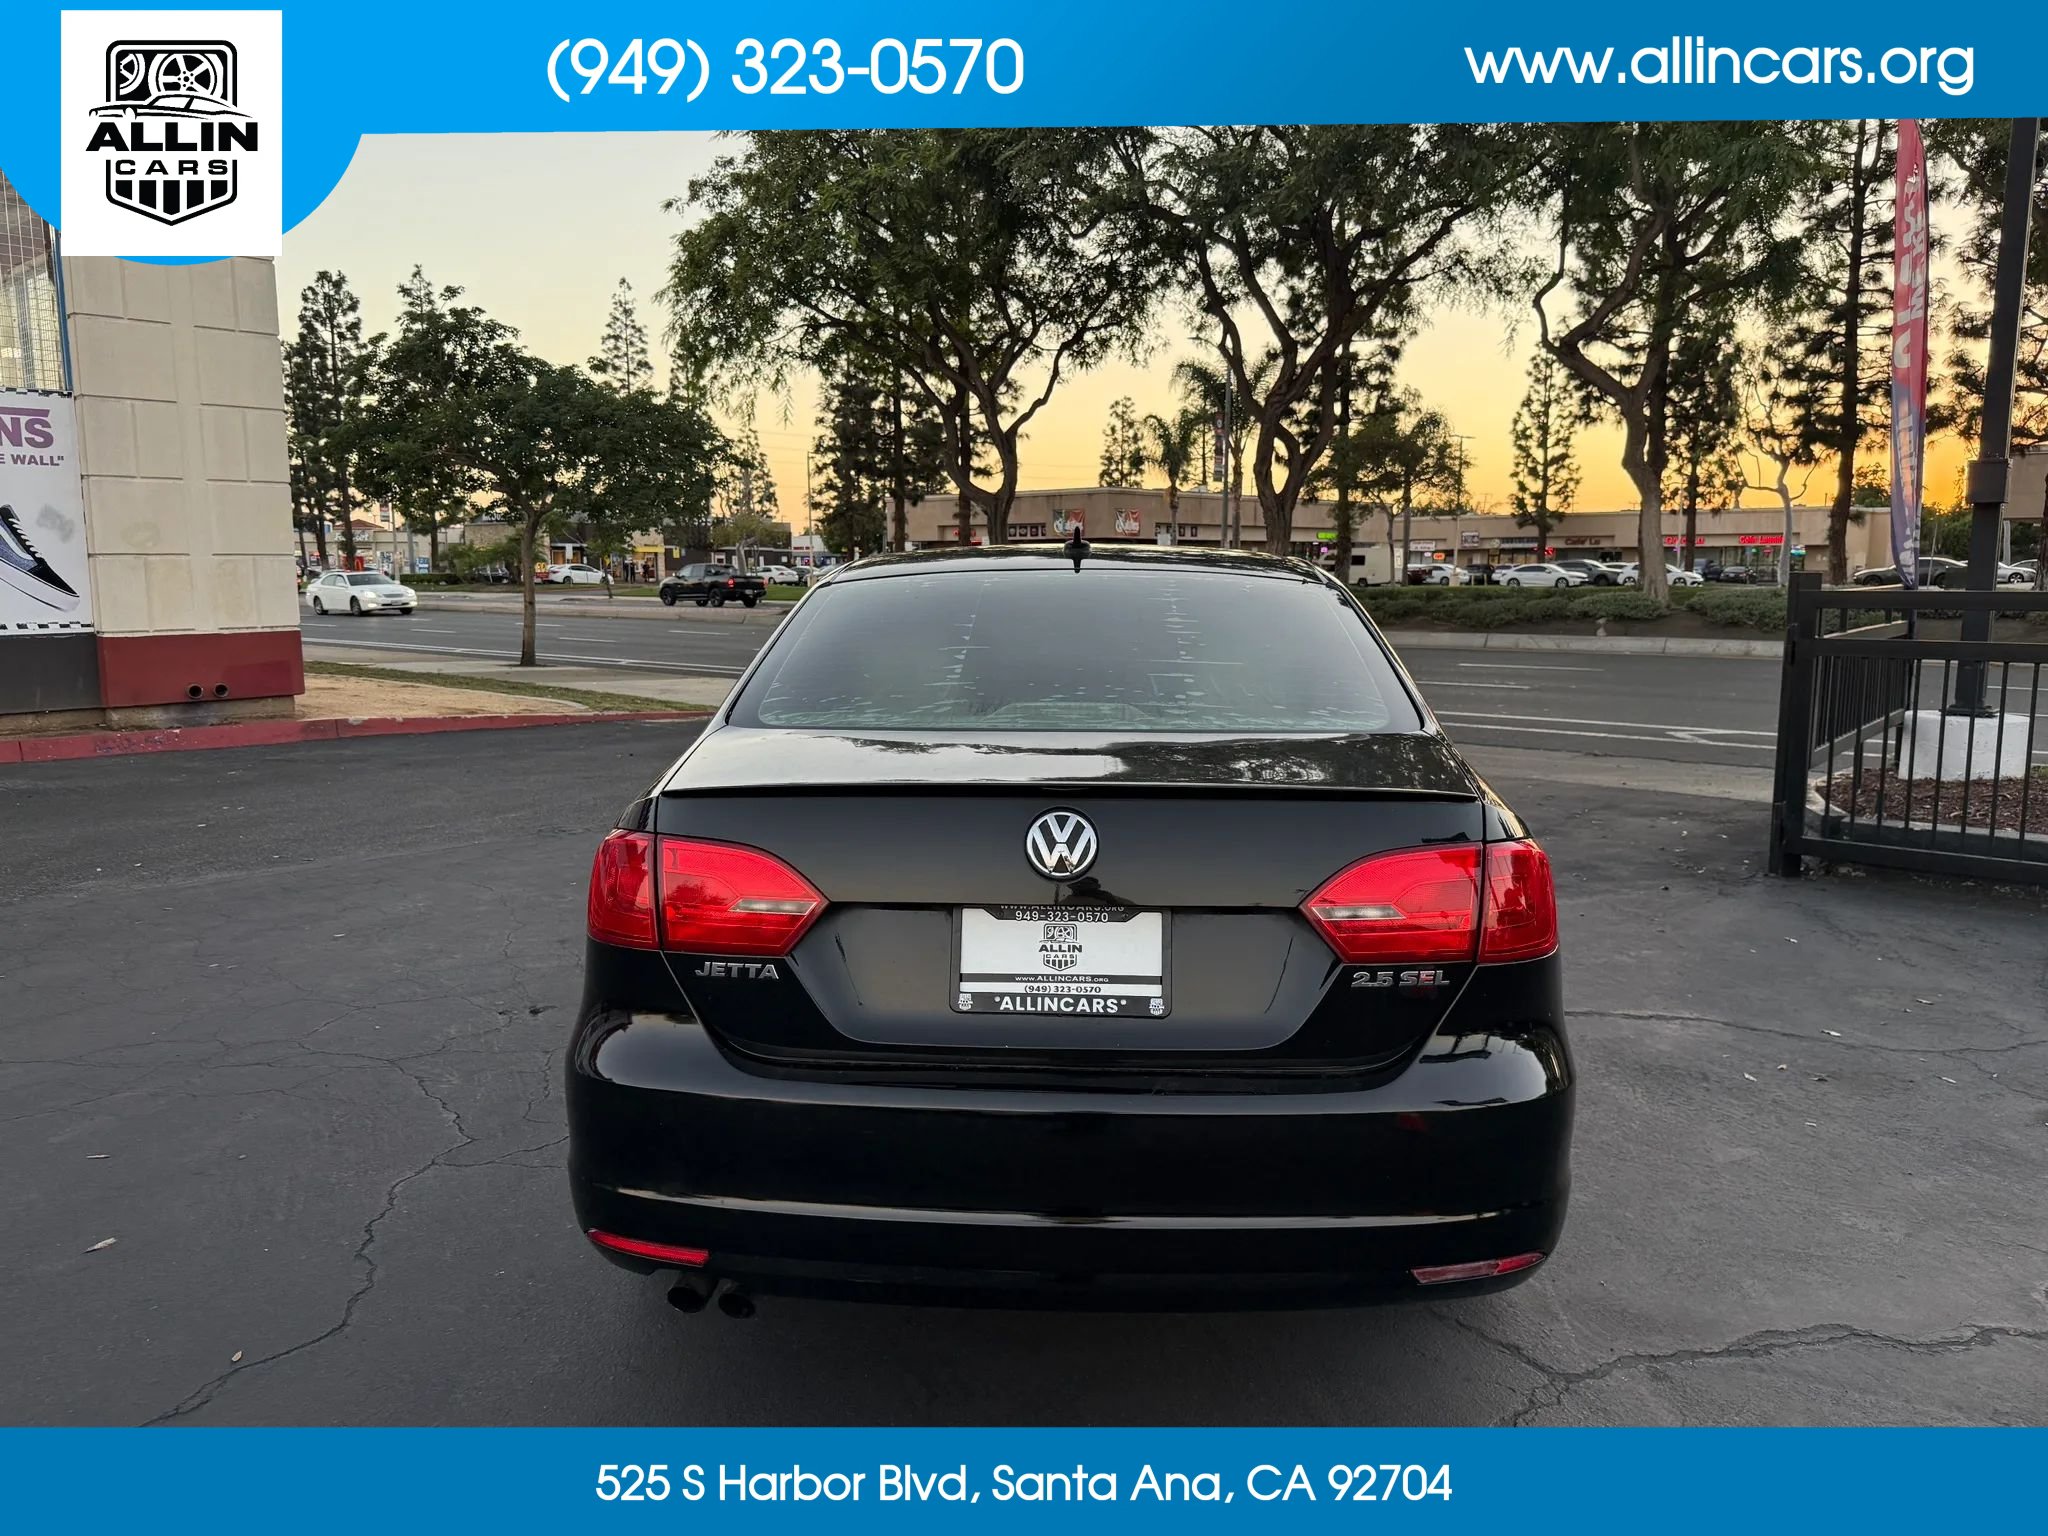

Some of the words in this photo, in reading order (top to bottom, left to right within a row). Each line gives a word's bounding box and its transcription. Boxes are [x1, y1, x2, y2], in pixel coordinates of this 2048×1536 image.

[1015, 910, 1109, 923] 949-323-0570
[1038, 944, 1083, 953] ALLIN
[694, 961, 779, 980] JETTA
[1351, 970, 1394, 988] 2.5
[1399, 970, 1450, 987] SEL
[1024, 985, 1051, 994] (949)
[1053, 985, 1101, 994] 323-0570
[1000, 995, 1119, 1013] ALLINCARS
